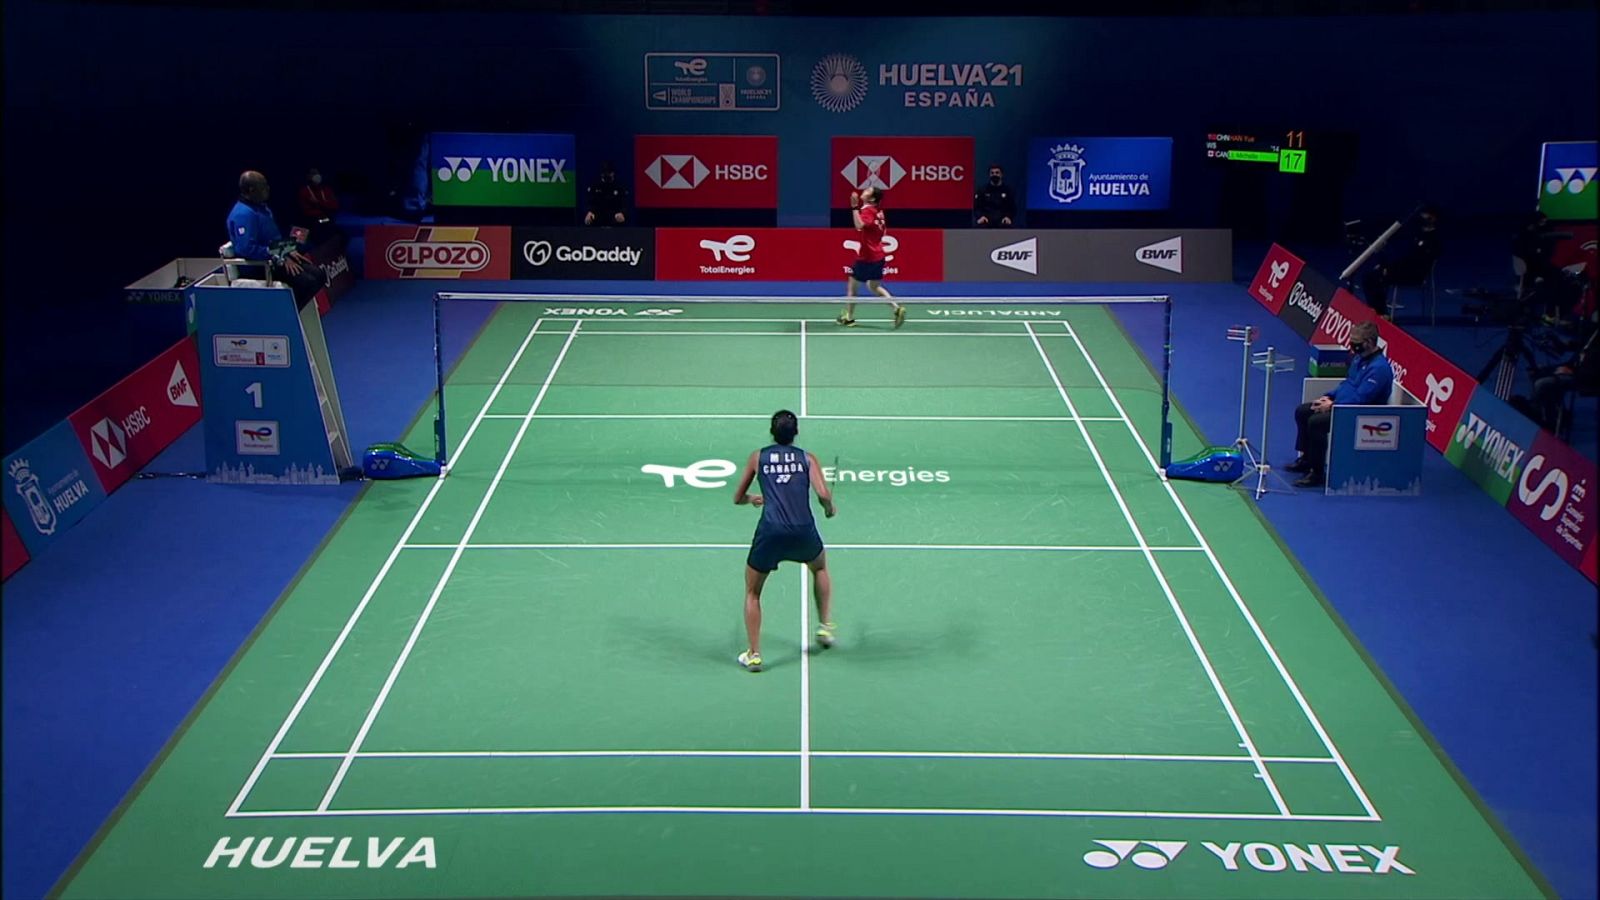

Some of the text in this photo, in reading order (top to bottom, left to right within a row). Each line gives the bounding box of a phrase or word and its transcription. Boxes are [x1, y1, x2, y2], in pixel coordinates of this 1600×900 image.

[904, 88, 995, 107] ESPAÑA
[1286, 130, 1304, 148] 11
[486, 157, 567, 183] YONEX
[1284, 153, 1303, 169] 17
[714, 165, 768, 181] HSBC
[911, 165, 964, 181] HSBC
[1089, 174, 1138, 182] Ayuntamiento
[1089, 183, 1150, 195] HUELVA
[556, 246, 642, 266] GoDaddy
[996, 251, 1033, 261] BWF
[1141, 249, 1178, 260] BWF
[700, 265, 755, 275] TotalEnergies
[543, 307, 628, 315] YONEX
[1321, 307, 1353, 350] TOYO
[169, 379, 188, 401] BWF
[245, 382, 262, 408] 1
[122, 405, 151, 439] HSBC
[785, 453, 795, 462] LI
[1481, 424, 1525, 484] YONEX
[763, 463, 804, 475] CANADA
[53, 479, 90, 514] HUELVA
[203, 836, 437, 869] HUELVA
[1200, 841, 1416, 875] YONEX
